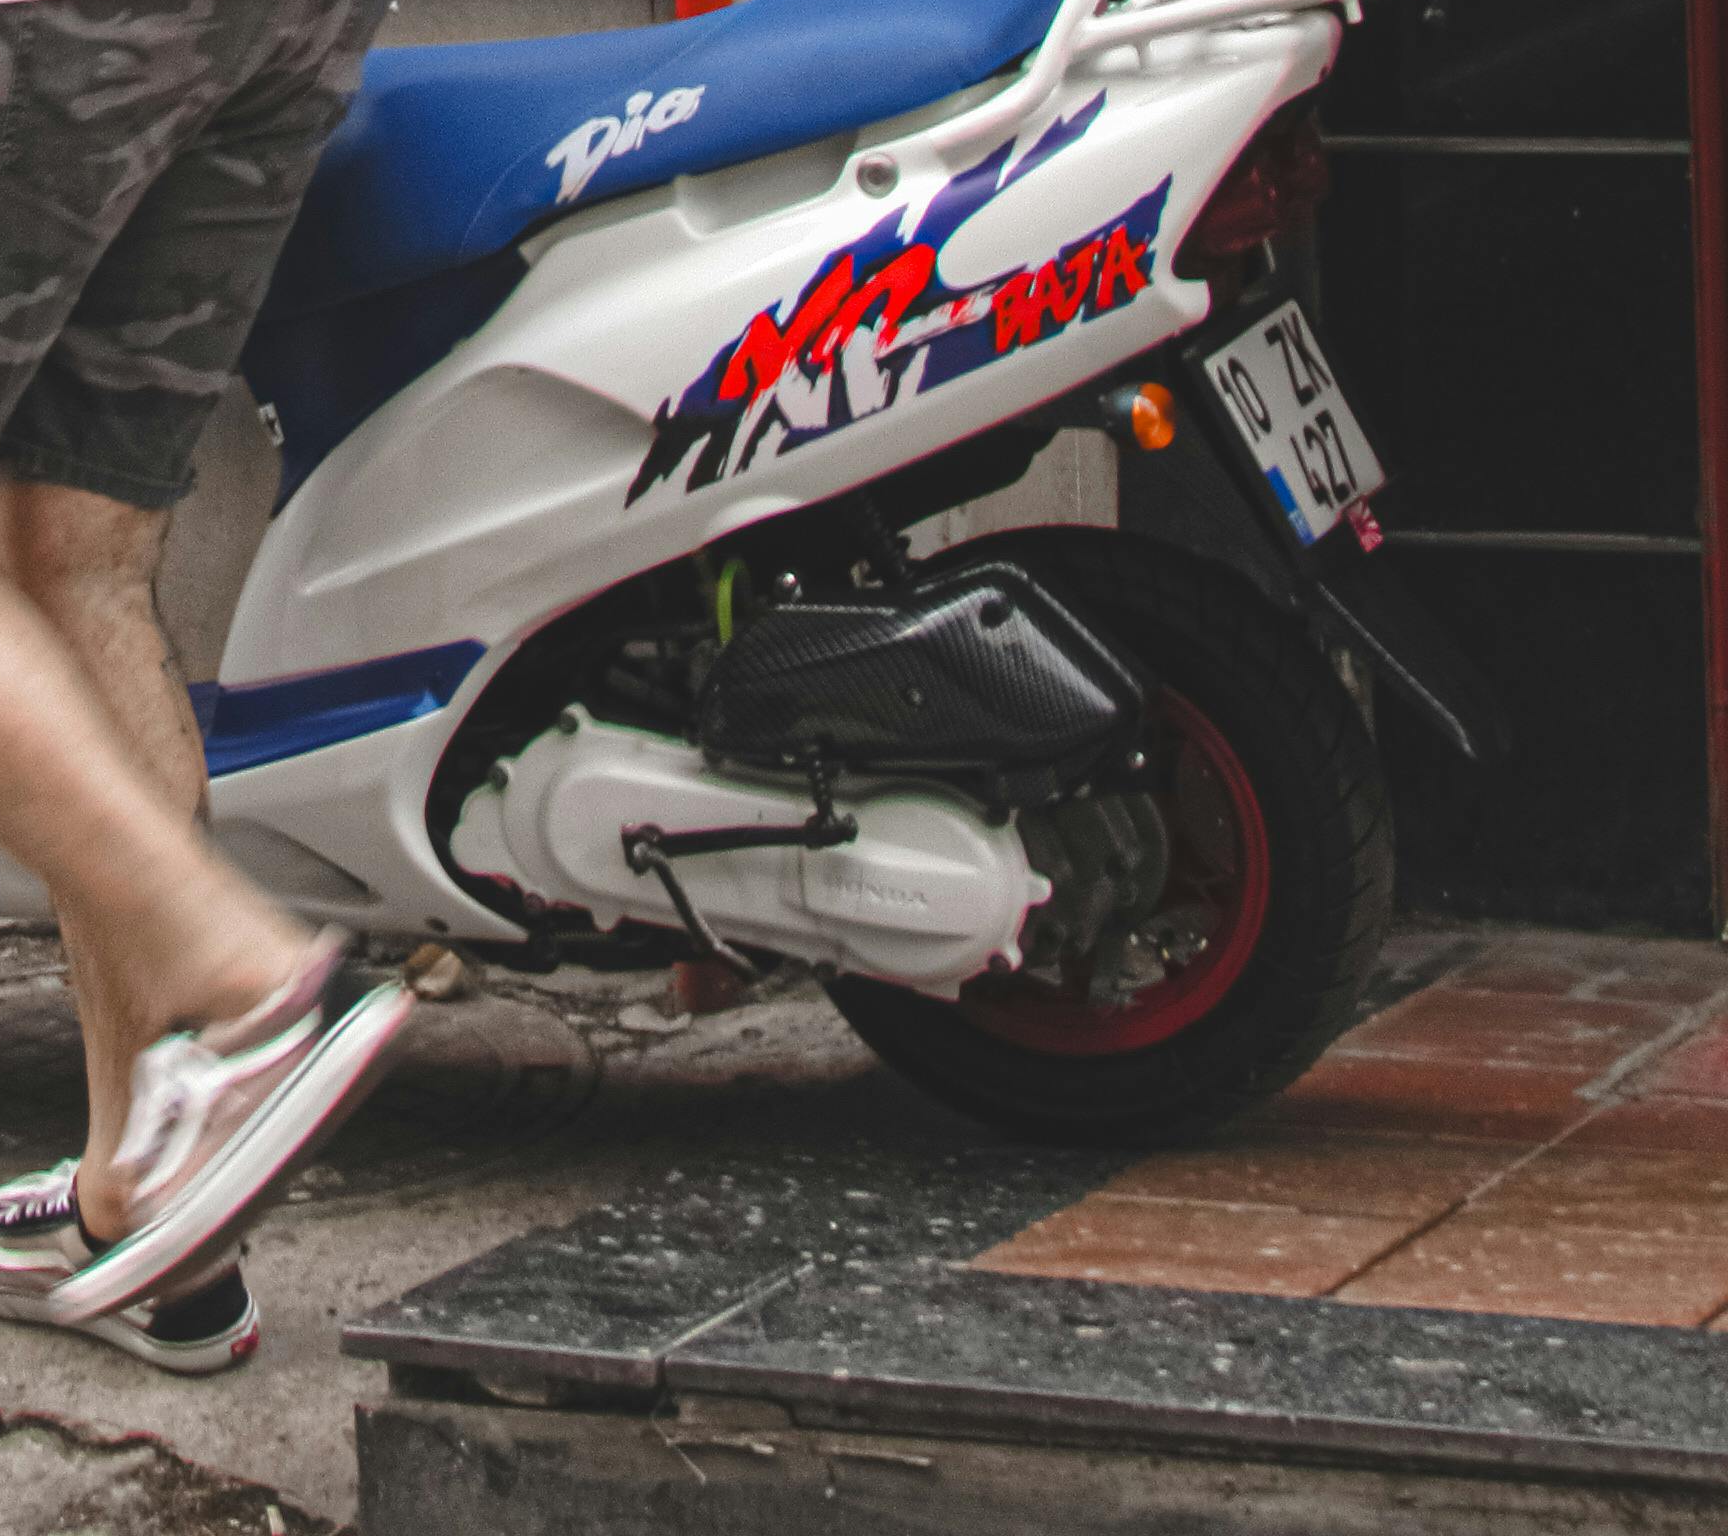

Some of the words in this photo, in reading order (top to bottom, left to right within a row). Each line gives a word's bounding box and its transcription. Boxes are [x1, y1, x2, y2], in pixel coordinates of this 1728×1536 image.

[545, 84, 706, 204] Dio
[990, 224, 1149, 354] BAJA
[1217, 356, 1272, 443] 10
[1263, 310, 1332, 408] ZK
[1289, 408, 1358, 510] 427
